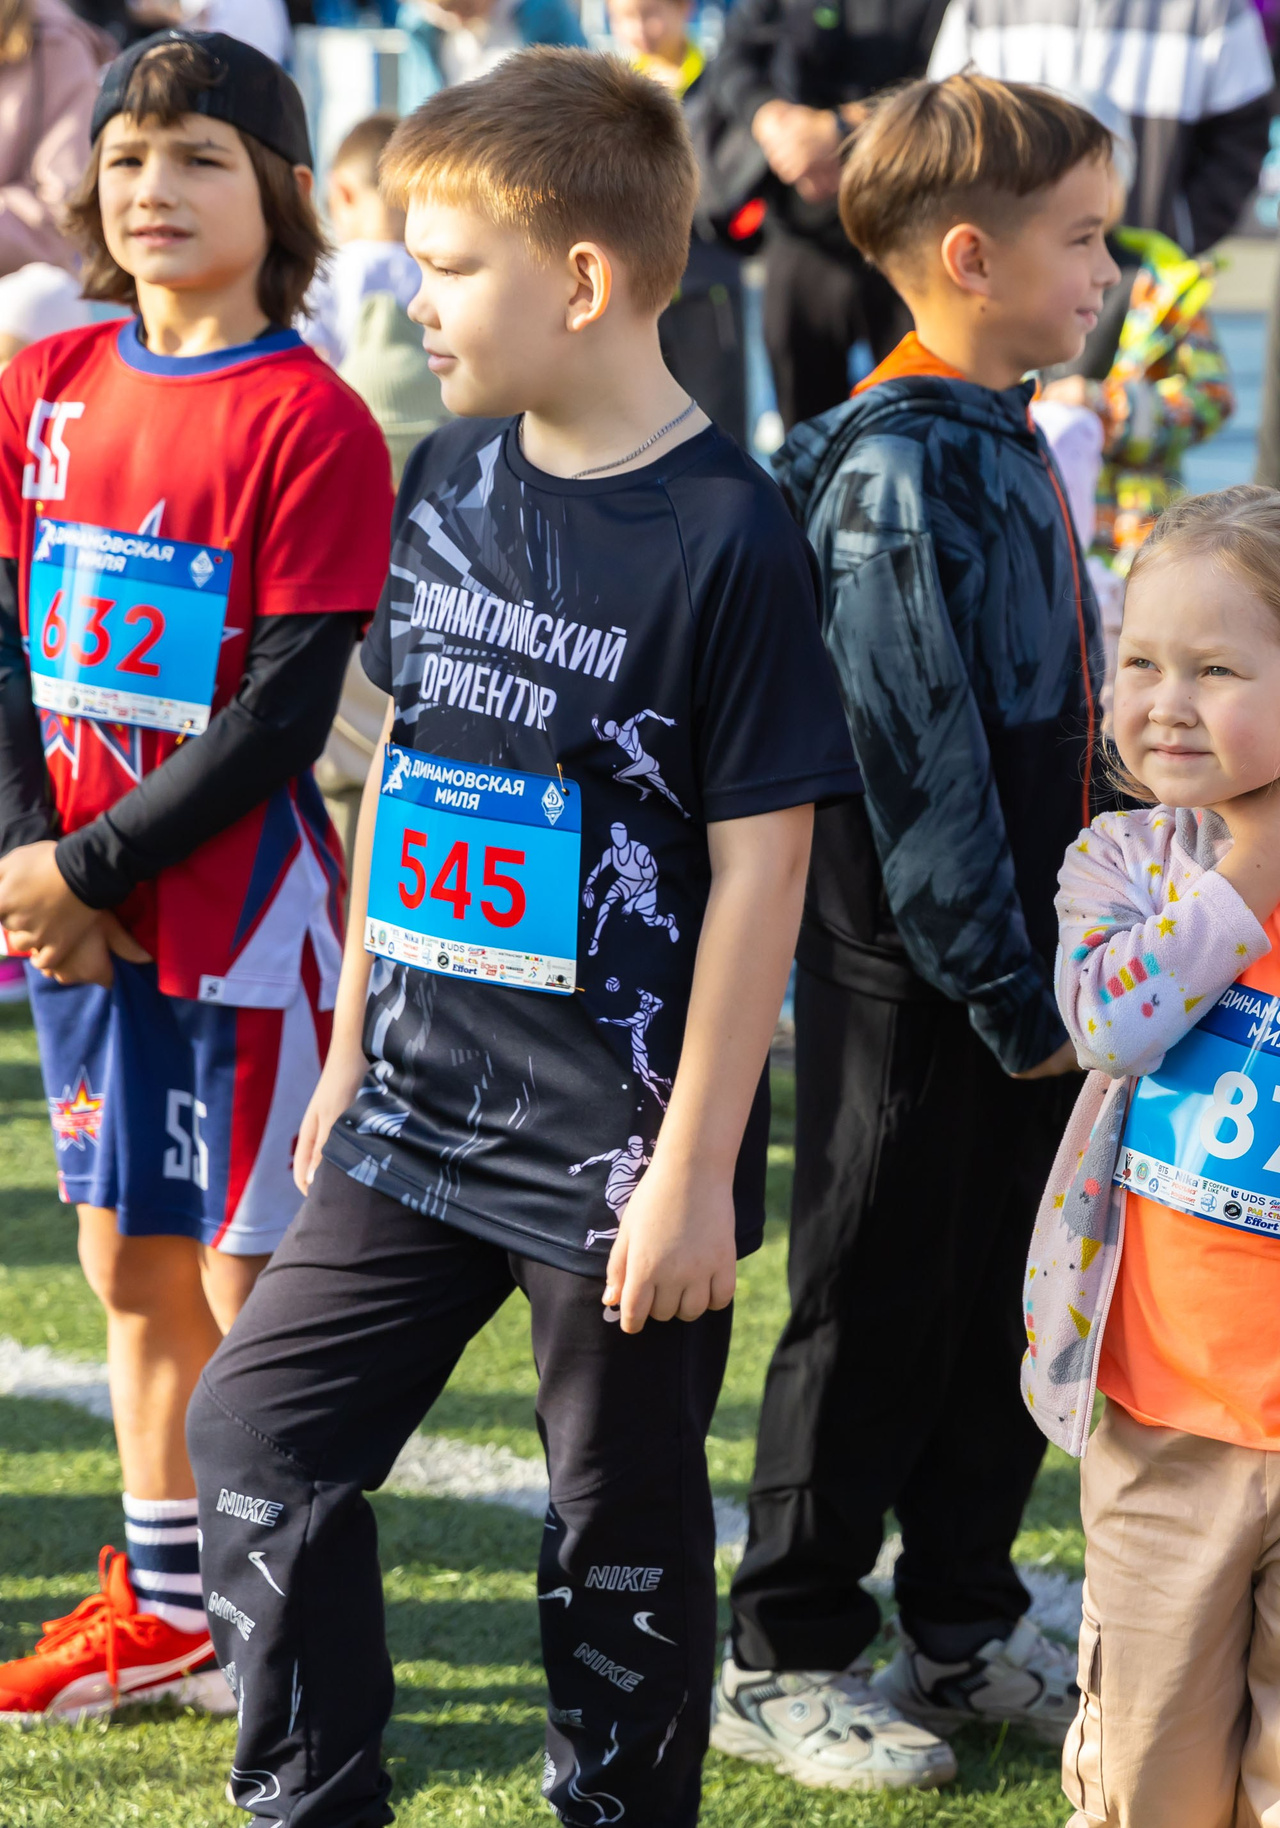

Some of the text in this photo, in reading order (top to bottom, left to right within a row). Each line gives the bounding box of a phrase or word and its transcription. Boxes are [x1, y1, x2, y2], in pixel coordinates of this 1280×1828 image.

[22, 398, 86, 500] 55
[41, 590, 166, 677] 632
[410, 580, 627, 682] ОЛИМПИЙСКИЙ
[420, 654, 557, 731] ОРИЕНТИР
[411, 759, 525, 797] ДИНАМОВСКАЯ
[434, 788, 481, 810] МИЛЯ
[398, 827, 526, 929] 545
[447, 942, 465, 953] UDS
[452, 964, 477, 975] Effort
[163, 1087, 209, 1192] 55
[1175, 1171, 1199, 1187] Nika
[1208, 1181, 1229, 1193] COFFEE
[1208, 1187, 1219, 1195] LIKE
[1241, 1192, 1266, 1206] UDS
[1244, 1215, 1279, 1231] Effort
[216, 1488, 284, 1527] NIKE
[585, 1566, 663, 1592] NIKE
[208, 1591, 256, 1641] NIKE
[573, 1642, 645, 1693] NIKE
